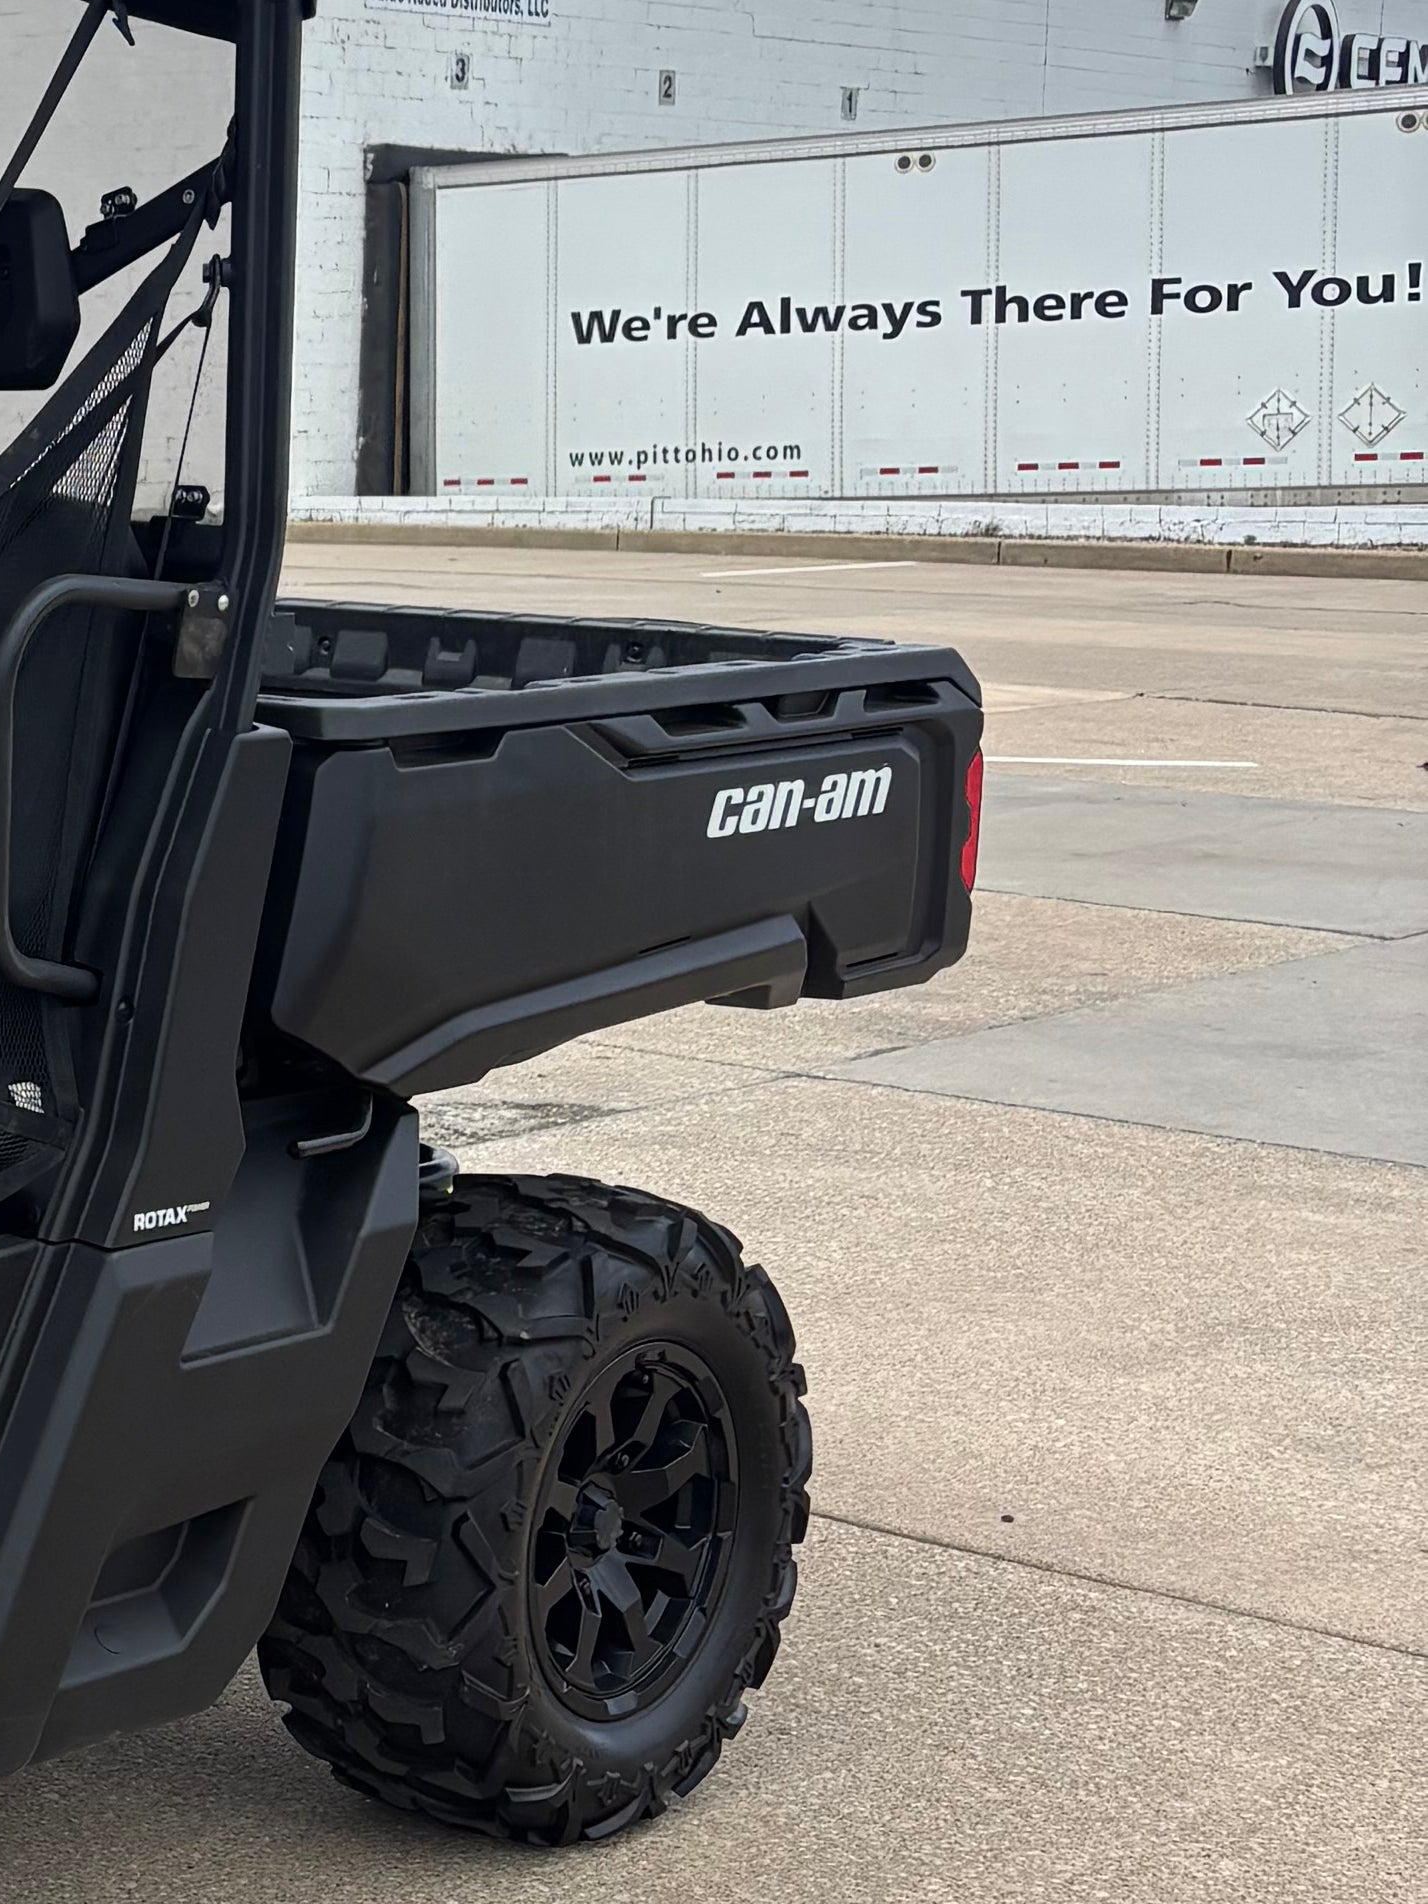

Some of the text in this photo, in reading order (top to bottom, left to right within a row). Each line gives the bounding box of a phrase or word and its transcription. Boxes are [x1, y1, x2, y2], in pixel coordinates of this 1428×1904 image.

[455, 57, 467, 84] 3
[662, 74, 673, 98] 2
[569, 262, 1423, 345] We're Always There For You!
[569, 441, 802, 470] www.pittohio.com
[706, 762, 893, 839] can-am
[133, 1204, 188, 1232] ROTAX
